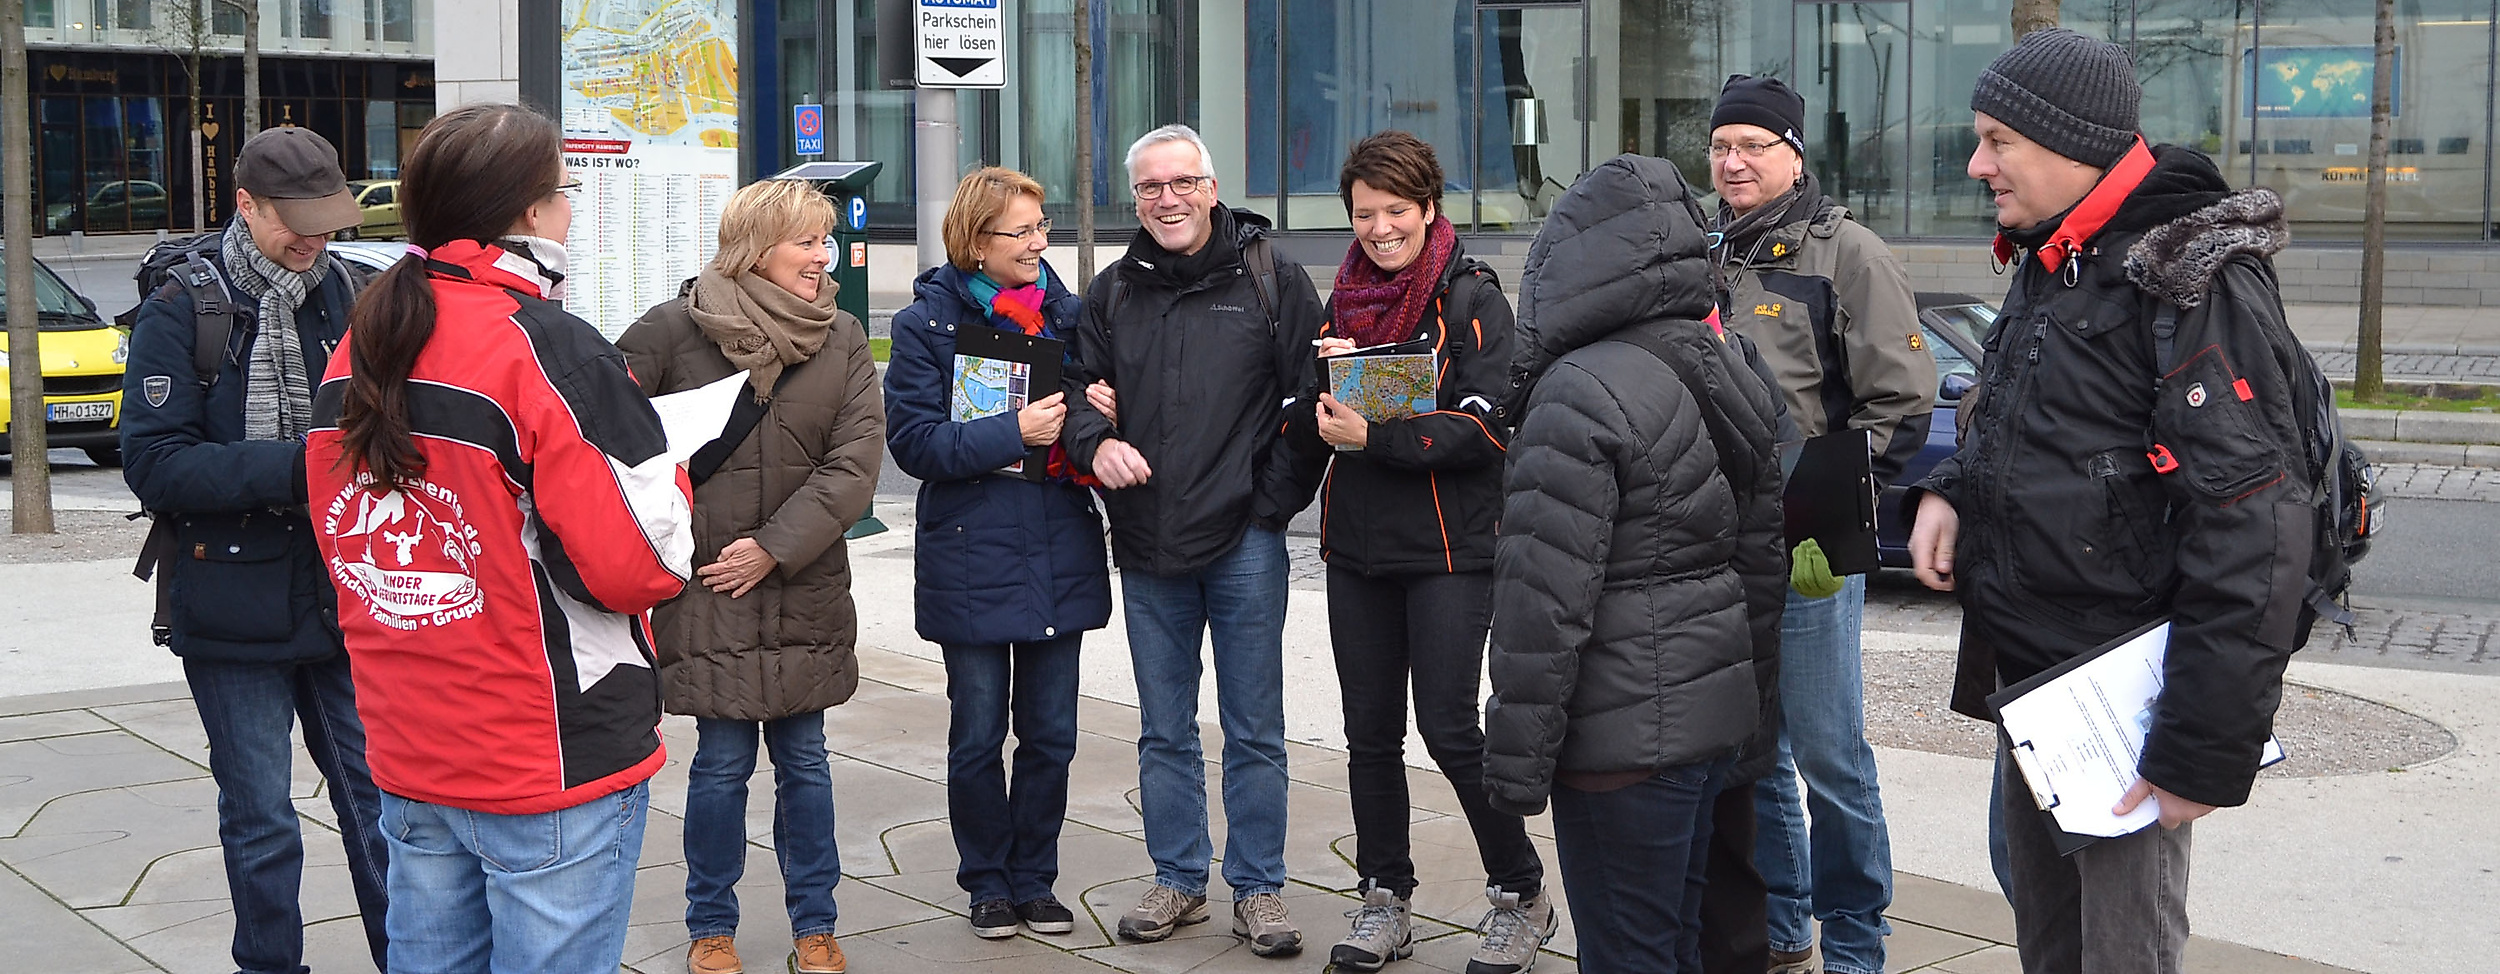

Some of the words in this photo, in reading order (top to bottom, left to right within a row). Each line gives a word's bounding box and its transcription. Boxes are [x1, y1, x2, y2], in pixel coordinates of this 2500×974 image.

[922, 12, 996, 29] Parkschein
[924, 33, 949, 49] hier
[960, 34, 996, 50] lösen
[206, 103, 214, 119] I
[283, 104, 291, 120] I
[798, 139, 821, 150] TAXI
[565, 157, 589, 168] WAS
[592, 157, 612, 168] IST
[615, 158, 640, 169] WO?
[206, 145, 217, 222] Hamburg
[852, 197, 865, 228] P
[368, 603, 418, 631] Familien
